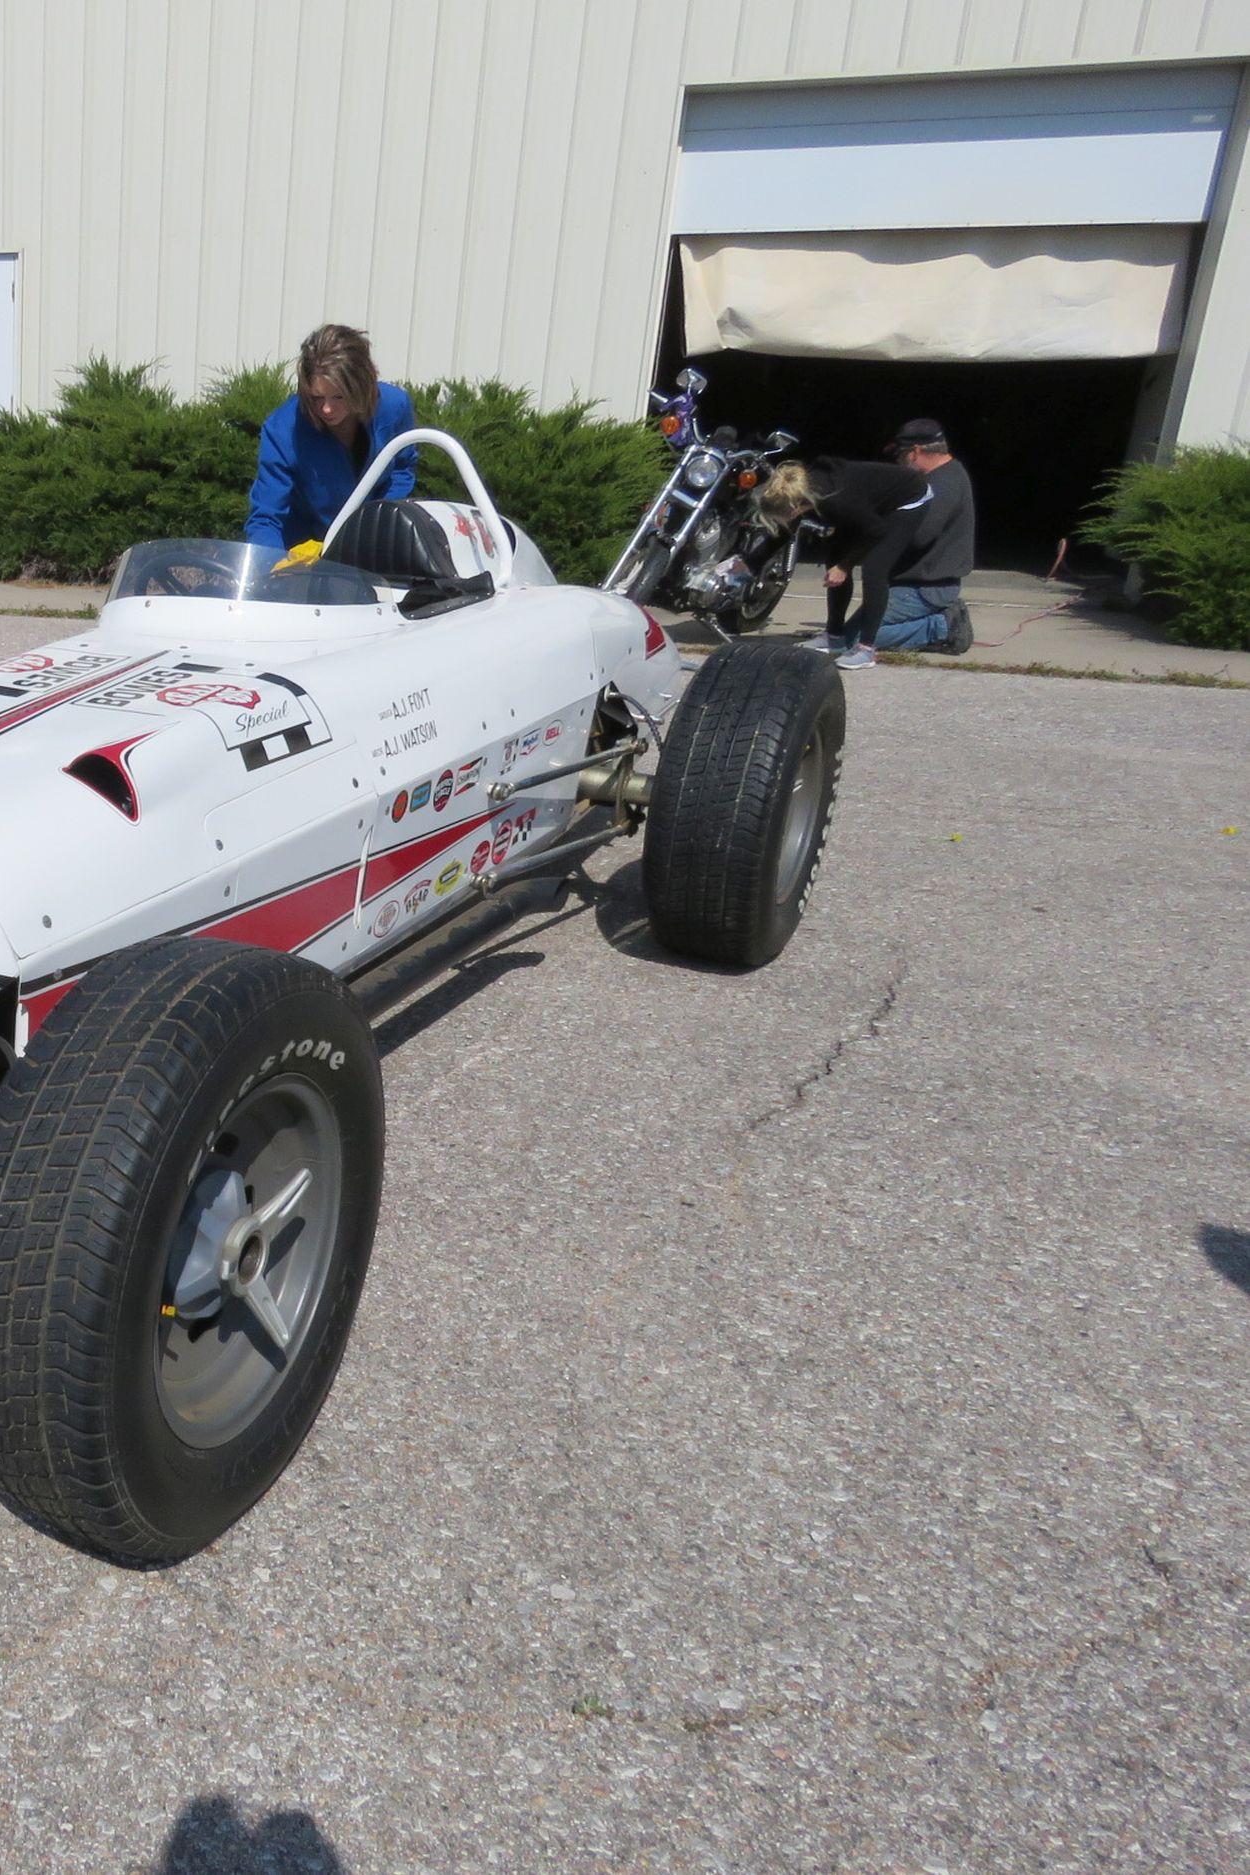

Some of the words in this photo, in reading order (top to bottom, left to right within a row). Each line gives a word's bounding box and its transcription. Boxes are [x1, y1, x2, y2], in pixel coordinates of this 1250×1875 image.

[13, 655, 116, 689] BOWES
[87, 670, 193, 707] BOWES
[235, 700, 289, 738] Special
[400, 720, 438, 751] WATSON
